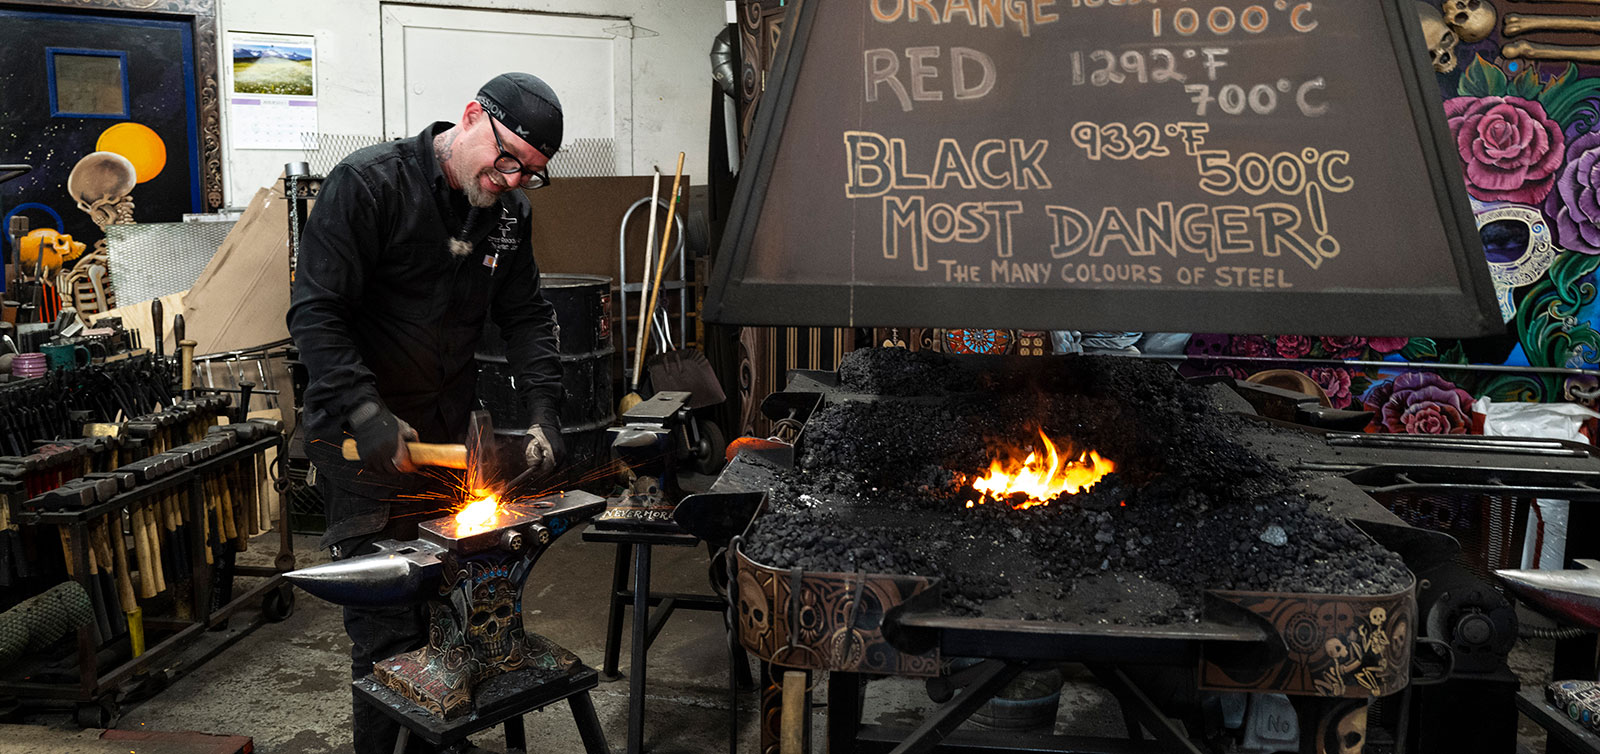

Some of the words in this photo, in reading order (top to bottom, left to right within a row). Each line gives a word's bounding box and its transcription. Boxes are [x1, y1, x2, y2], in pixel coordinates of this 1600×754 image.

[870, 0, 1059, 37] ORANGE
[1152, 0, 1319, 36] 1000°C
[864, 46, 997, 111] RED
[1070, 48, 1230, 86] 1292°F
[1184, 77, 1328, 117] 700°C
[844, 130, 1052, 199] BLACK
[1071, 121, 1209, 160] 932°F
[1199, 147, 1354, 196] 500°C
[882, 196, 1023, 271] MOST
[1046, 181, 1341, 270] DANGER!
[938, 259, 981, 284] THE
[991, 261, 1052, 285] MANY
[1061, 263, 1164, 285] COLOURS
[1177, 264, 1205, 286] OF
[1215, 266, 1293, 289] STEEL
[1267, 714, 1290, 733] No
